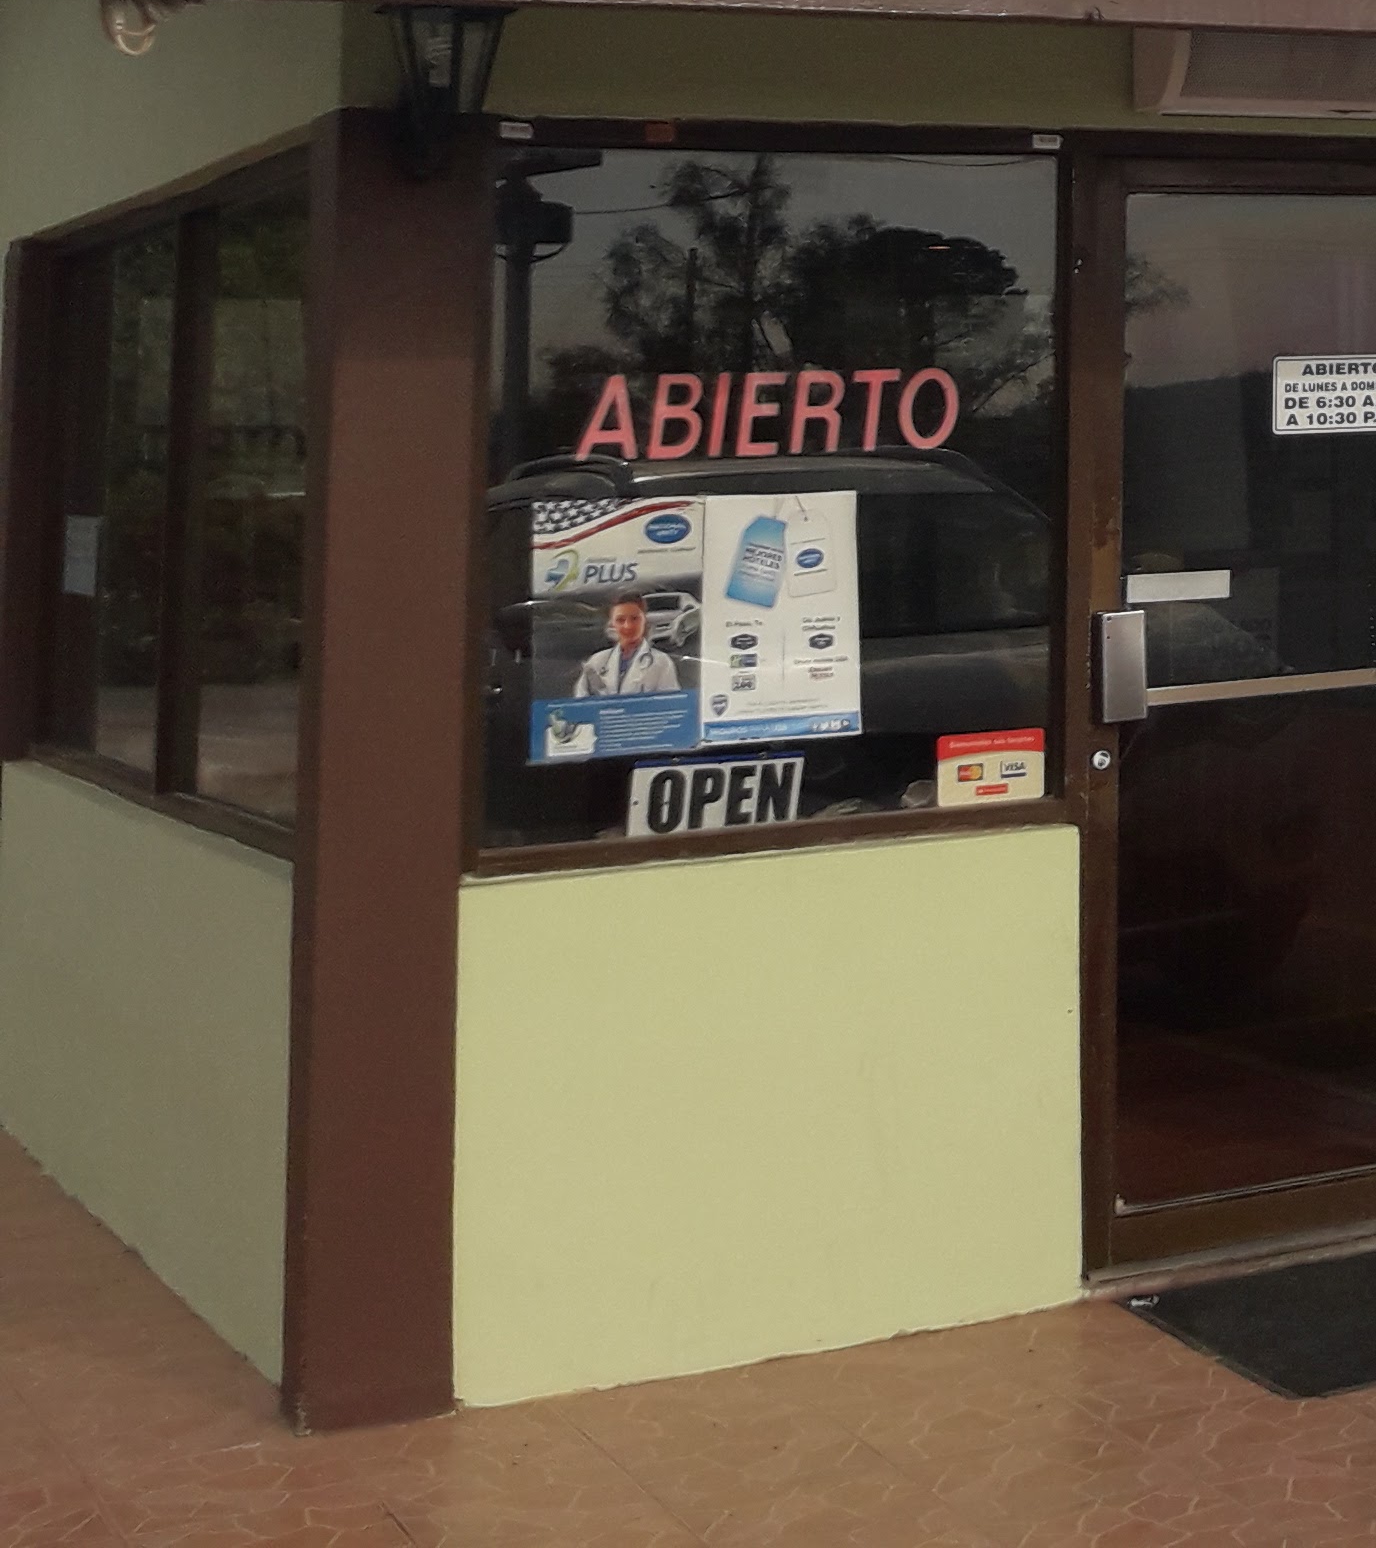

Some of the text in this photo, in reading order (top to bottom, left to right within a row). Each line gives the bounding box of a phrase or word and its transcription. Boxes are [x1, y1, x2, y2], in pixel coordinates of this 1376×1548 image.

[1284, 383, 1299, 393] DE
[1302, 382, 1338, 393] LUNES
[1340, 382, 1349, 391] A
[1284, 397, 1310, 409] DE
[1316, 395, 1356, 409] 6:30
[575, 367, 960, 461] ABIERTO
[1286, 413, 1299, 426] A
[1306, 412, 1357, 425] 10:30
[583, 562, 639, 584] PLUS
[1004, 762, 1026, 771] VISA
[647, 761, 798, 834] OPEN
